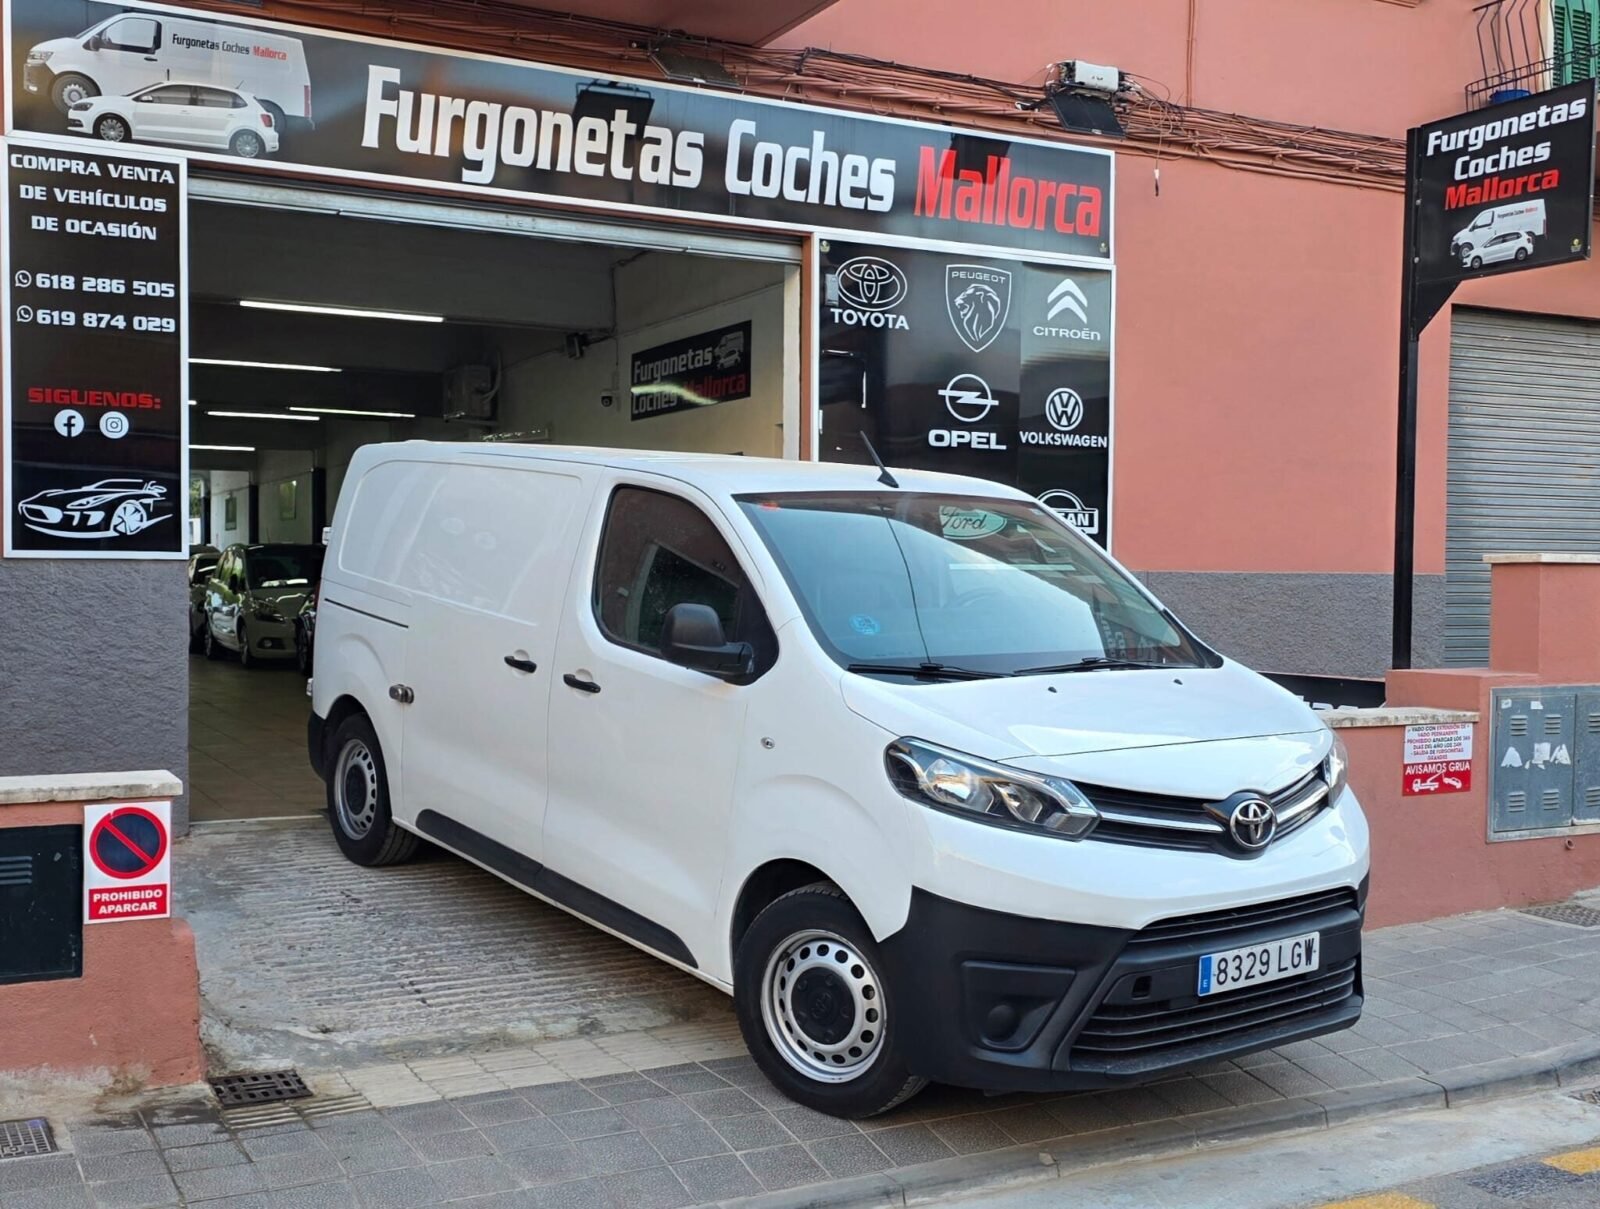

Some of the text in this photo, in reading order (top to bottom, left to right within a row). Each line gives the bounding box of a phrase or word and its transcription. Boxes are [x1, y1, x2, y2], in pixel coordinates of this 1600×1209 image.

[172, 33, 287, 60] Furgonetas Coches Mallorca
[1426, 98, 1587, 157] Furgonetas
[361, 64, 1102, 237] Furgonetas Coches Mallorca
[1454, 141, 1551, 181] Coches
[10, 153, 175, 184] COMPRA VENTA
[19, 184, 167, 212] DE VEHÍCULOS
[1444, 169, 1561, 211] Mallorca
[31, 215, 157, 240] DE OCASIÓN
[35, 273, 175, 298] 618 286 505
[951, 270, 1006, 284] PEUGEOT
[36, 309, 176, 333] 619 874 029
[830, 307, 910, 331] TOYOTA
[633, 346, 713, 385] Furgonetas
[27, 387, 161, 409] SIGUENOS:
[928, 429, 1007, 451] OPEL
[1019, 431, 1108, 449] VOLKSWAGEN
[940, 505, 987, 531] Ford
[1405, 760, 1471, 775] AVISAMOS GRUA
[93, 889, 163, 903] PROHIBIDO
[98, 901, 158, 914] APARCAR
[1216, 938, 1315, 985] 8329 LGW
